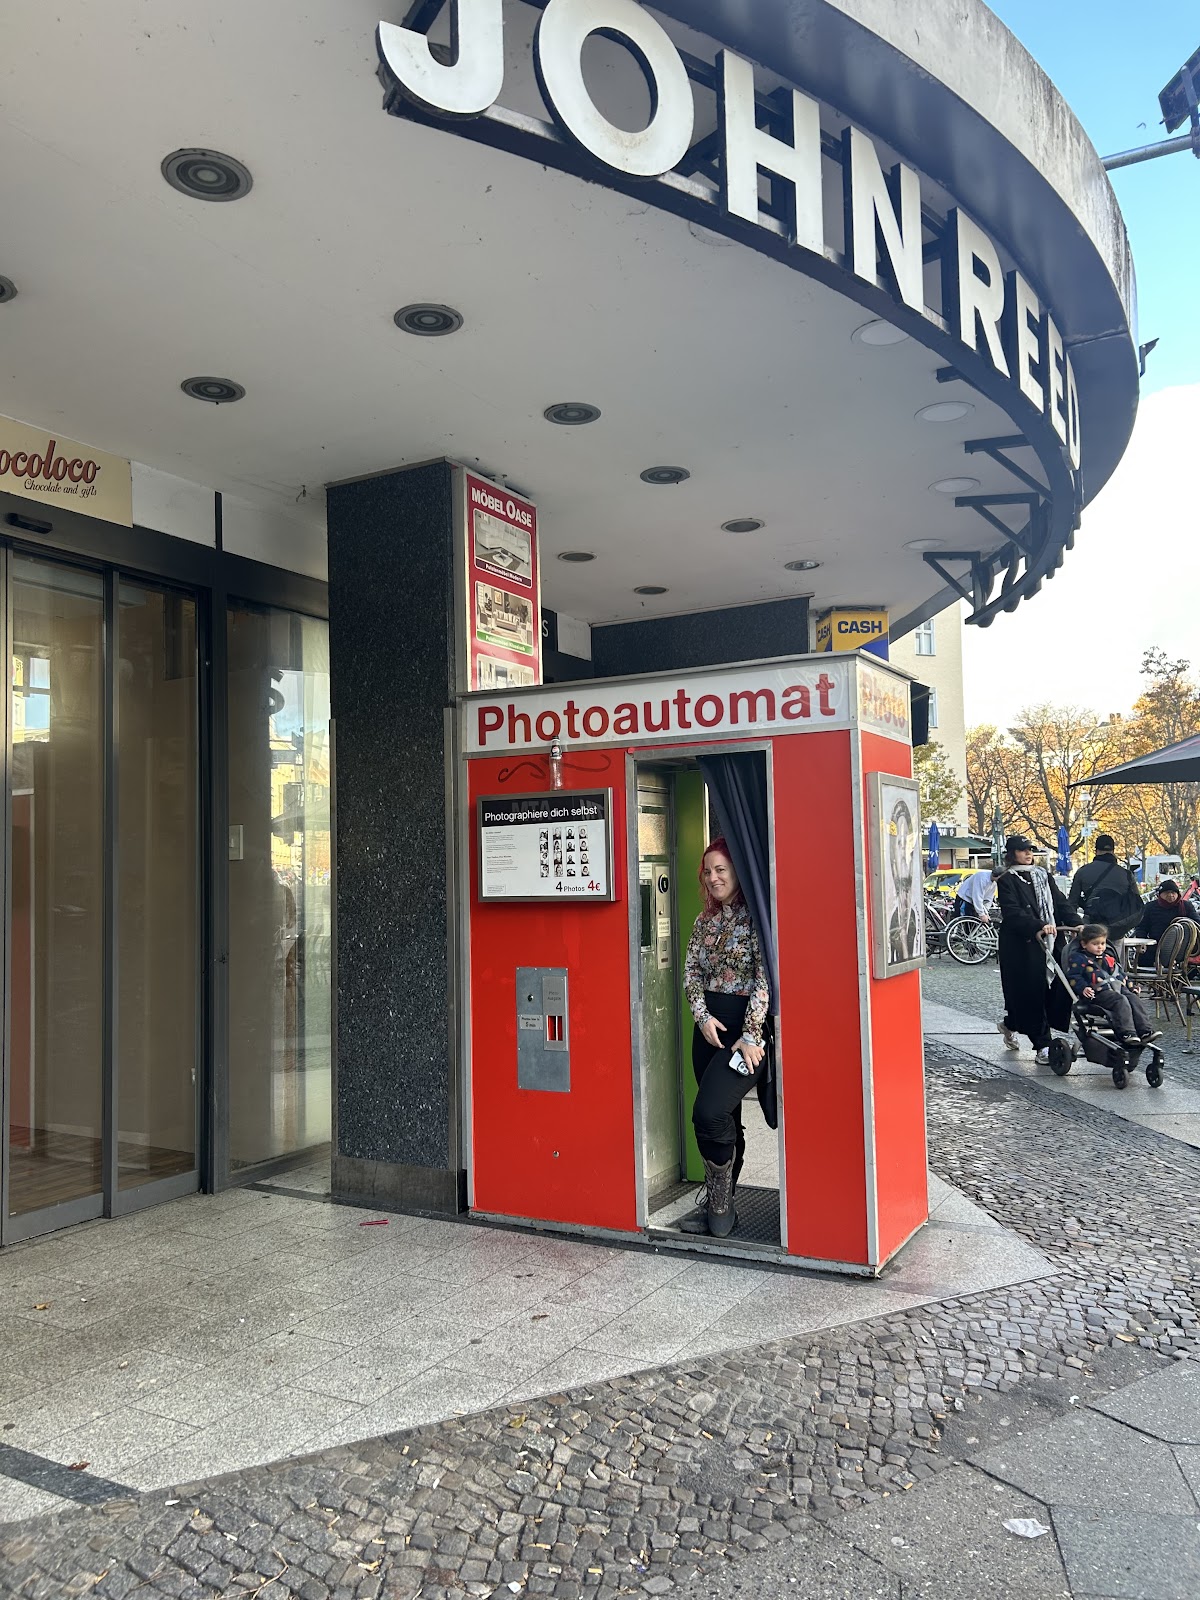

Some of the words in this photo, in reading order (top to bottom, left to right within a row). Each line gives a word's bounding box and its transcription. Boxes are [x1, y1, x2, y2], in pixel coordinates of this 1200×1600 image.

[378, 0, 923, 314] JOHN
[957, 207, 1081, 470] REED
[24, 479, 61, 493] Chocolate
[63, 484, 79, 494] and
[79, 486, 97, 498] gifts
[471, 487, 506, 516] MÖBEL
[506, 500, 532, 528] OASE
[837, 621, 883, 634] CASH
[477, 674, 836, 746] Photoautomat
[484, 809, 549, 822] Photographiere
[550, 808, 569, 817] dich
[571, 805, 598, 816] selbst
[555, 881, 563, 892] 4
[587, 880, 601, 891] 4€
